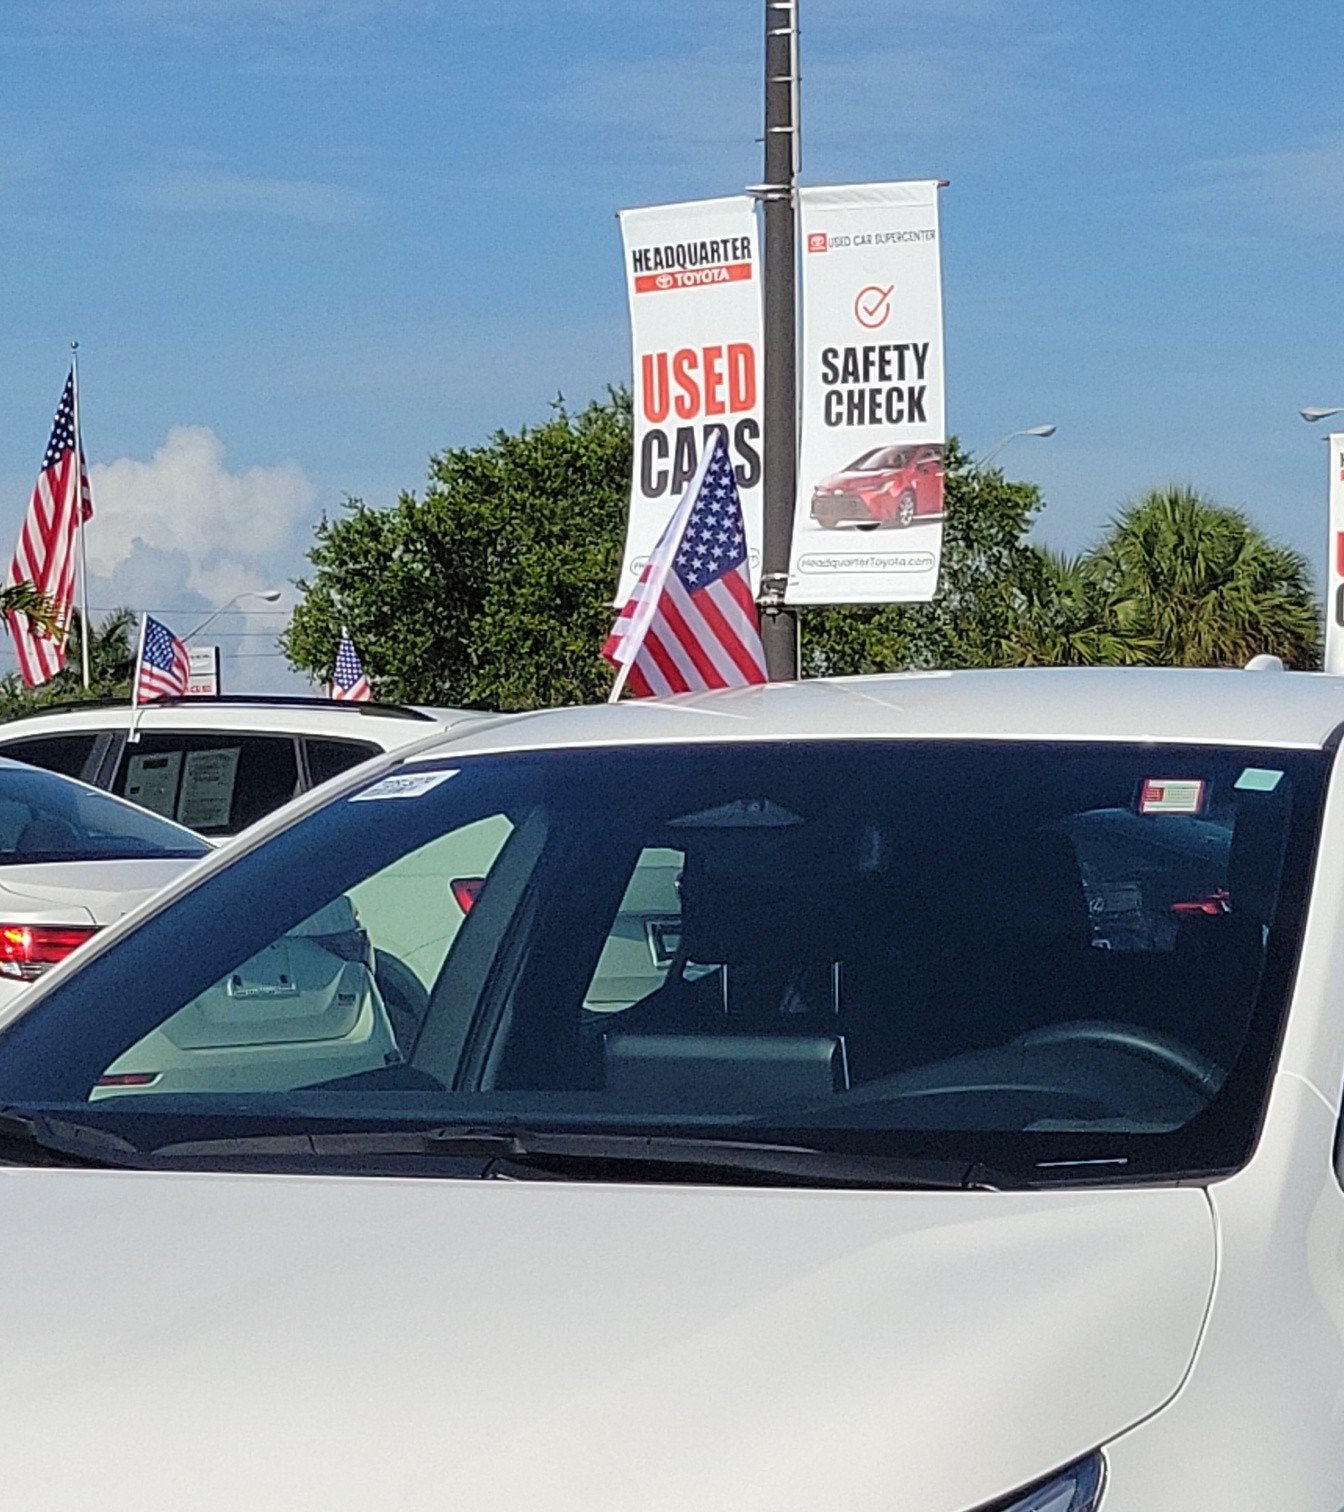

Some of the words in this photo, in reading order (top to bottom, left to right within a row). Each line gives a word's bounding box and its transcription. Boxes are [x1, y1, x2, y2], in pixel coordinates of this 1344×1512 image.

[632, 236, 752, 273] HEADQUARTER
[674, 267, 730, 287] TOYOTA
[642, 343, 757, 423] USED
[821, 342, 929, 385] SAFETY
[824, 385, 927, 427] CHECK
